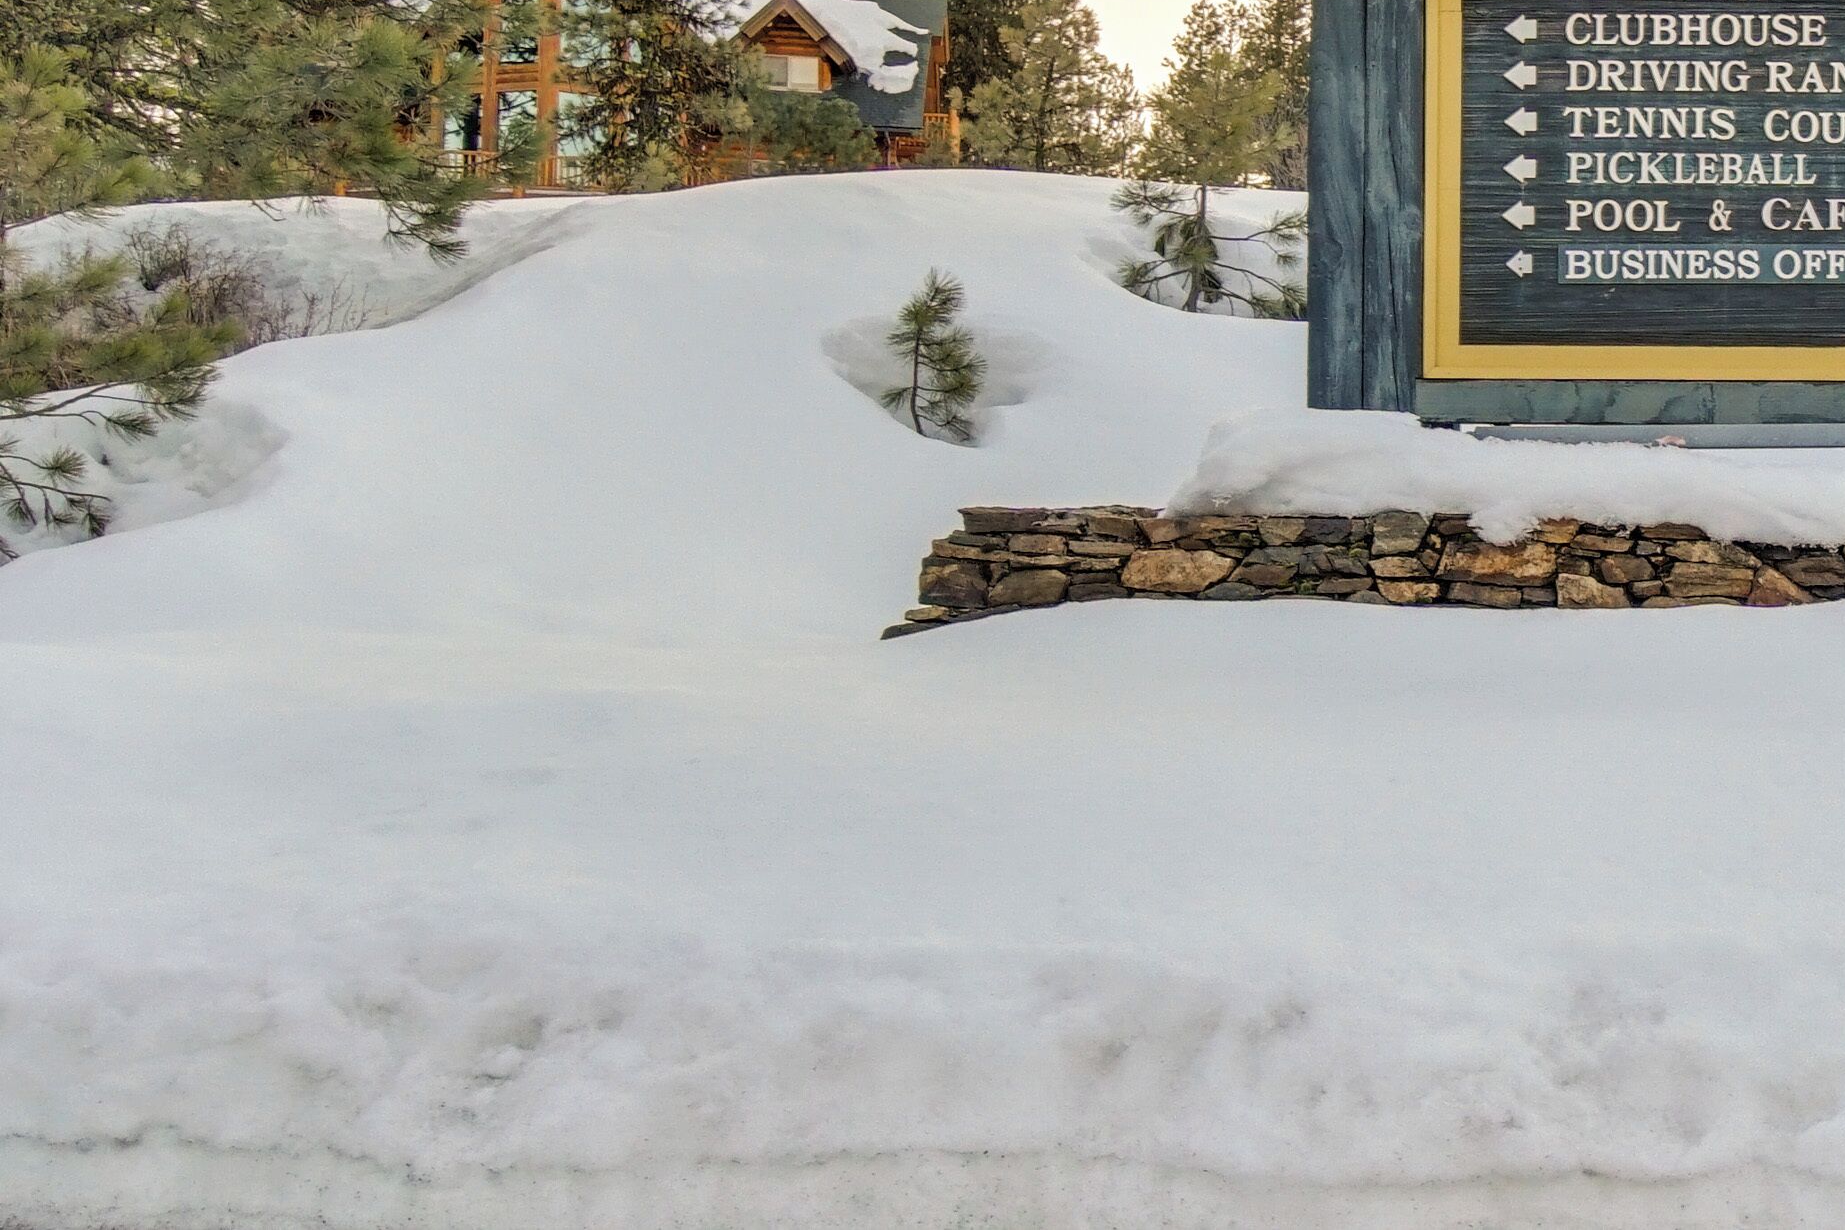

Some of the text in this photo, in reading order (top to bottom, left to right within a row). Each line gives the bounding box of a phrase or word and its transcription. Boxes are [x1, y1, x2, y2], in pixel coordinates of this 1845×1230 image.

[1564, 13, 1828, 47] CLUBHOUSE
[1564, 59, 1752, 92] DRIVING
[1562, 105, 1737, 140] TENNIS
[1565, 151, 1818, 185] PICKLEBALL
[1564, 198, 1682, 233] POOL
[1707, 198, 1733, 233] &
[1564, 248, 1760, 281] BUSINESS
